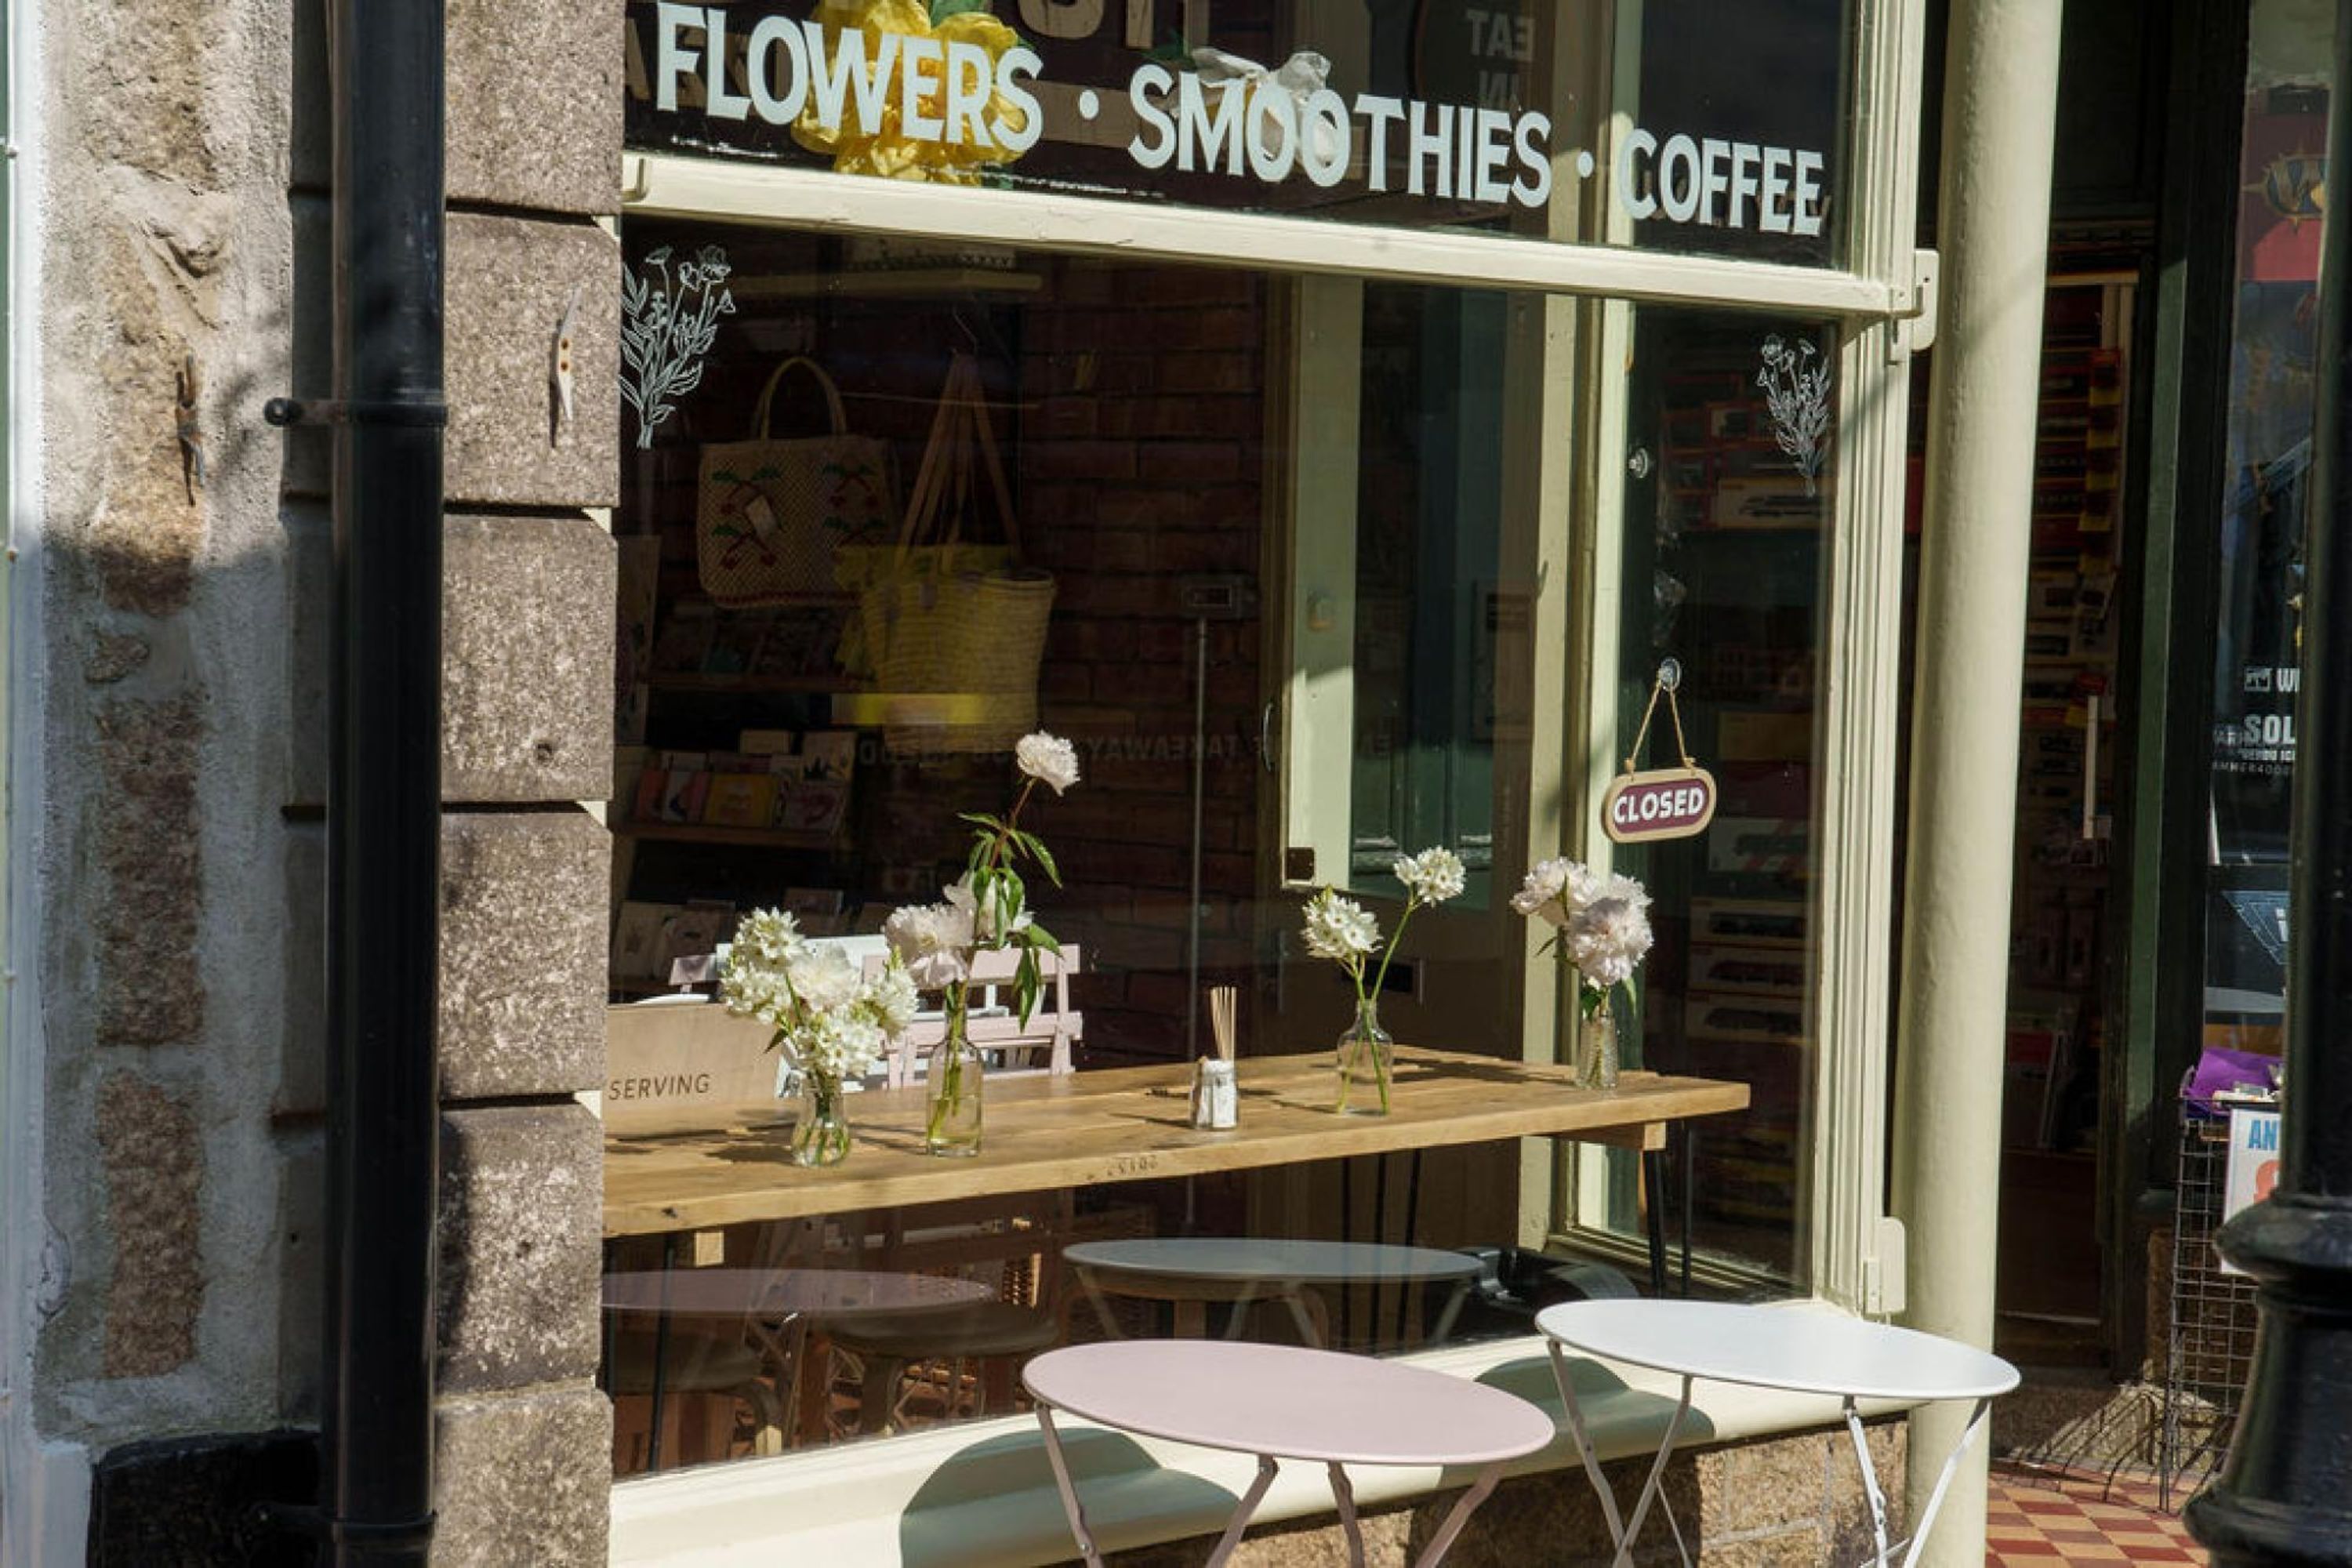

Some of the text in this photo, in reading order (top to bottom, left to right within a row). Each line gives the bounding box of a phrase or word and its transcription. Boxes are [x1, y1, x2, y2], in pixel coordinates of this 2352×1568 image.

[656, 1, 1044, 153] FLOWERS
[1127, 64, 1553, 208] SMOOTHIES
[1620, 128, 1825, 236] COFFEE
[1614, 787, 1704, 824] CLOSED
[608, 1073, 711, 1100] SERVING
